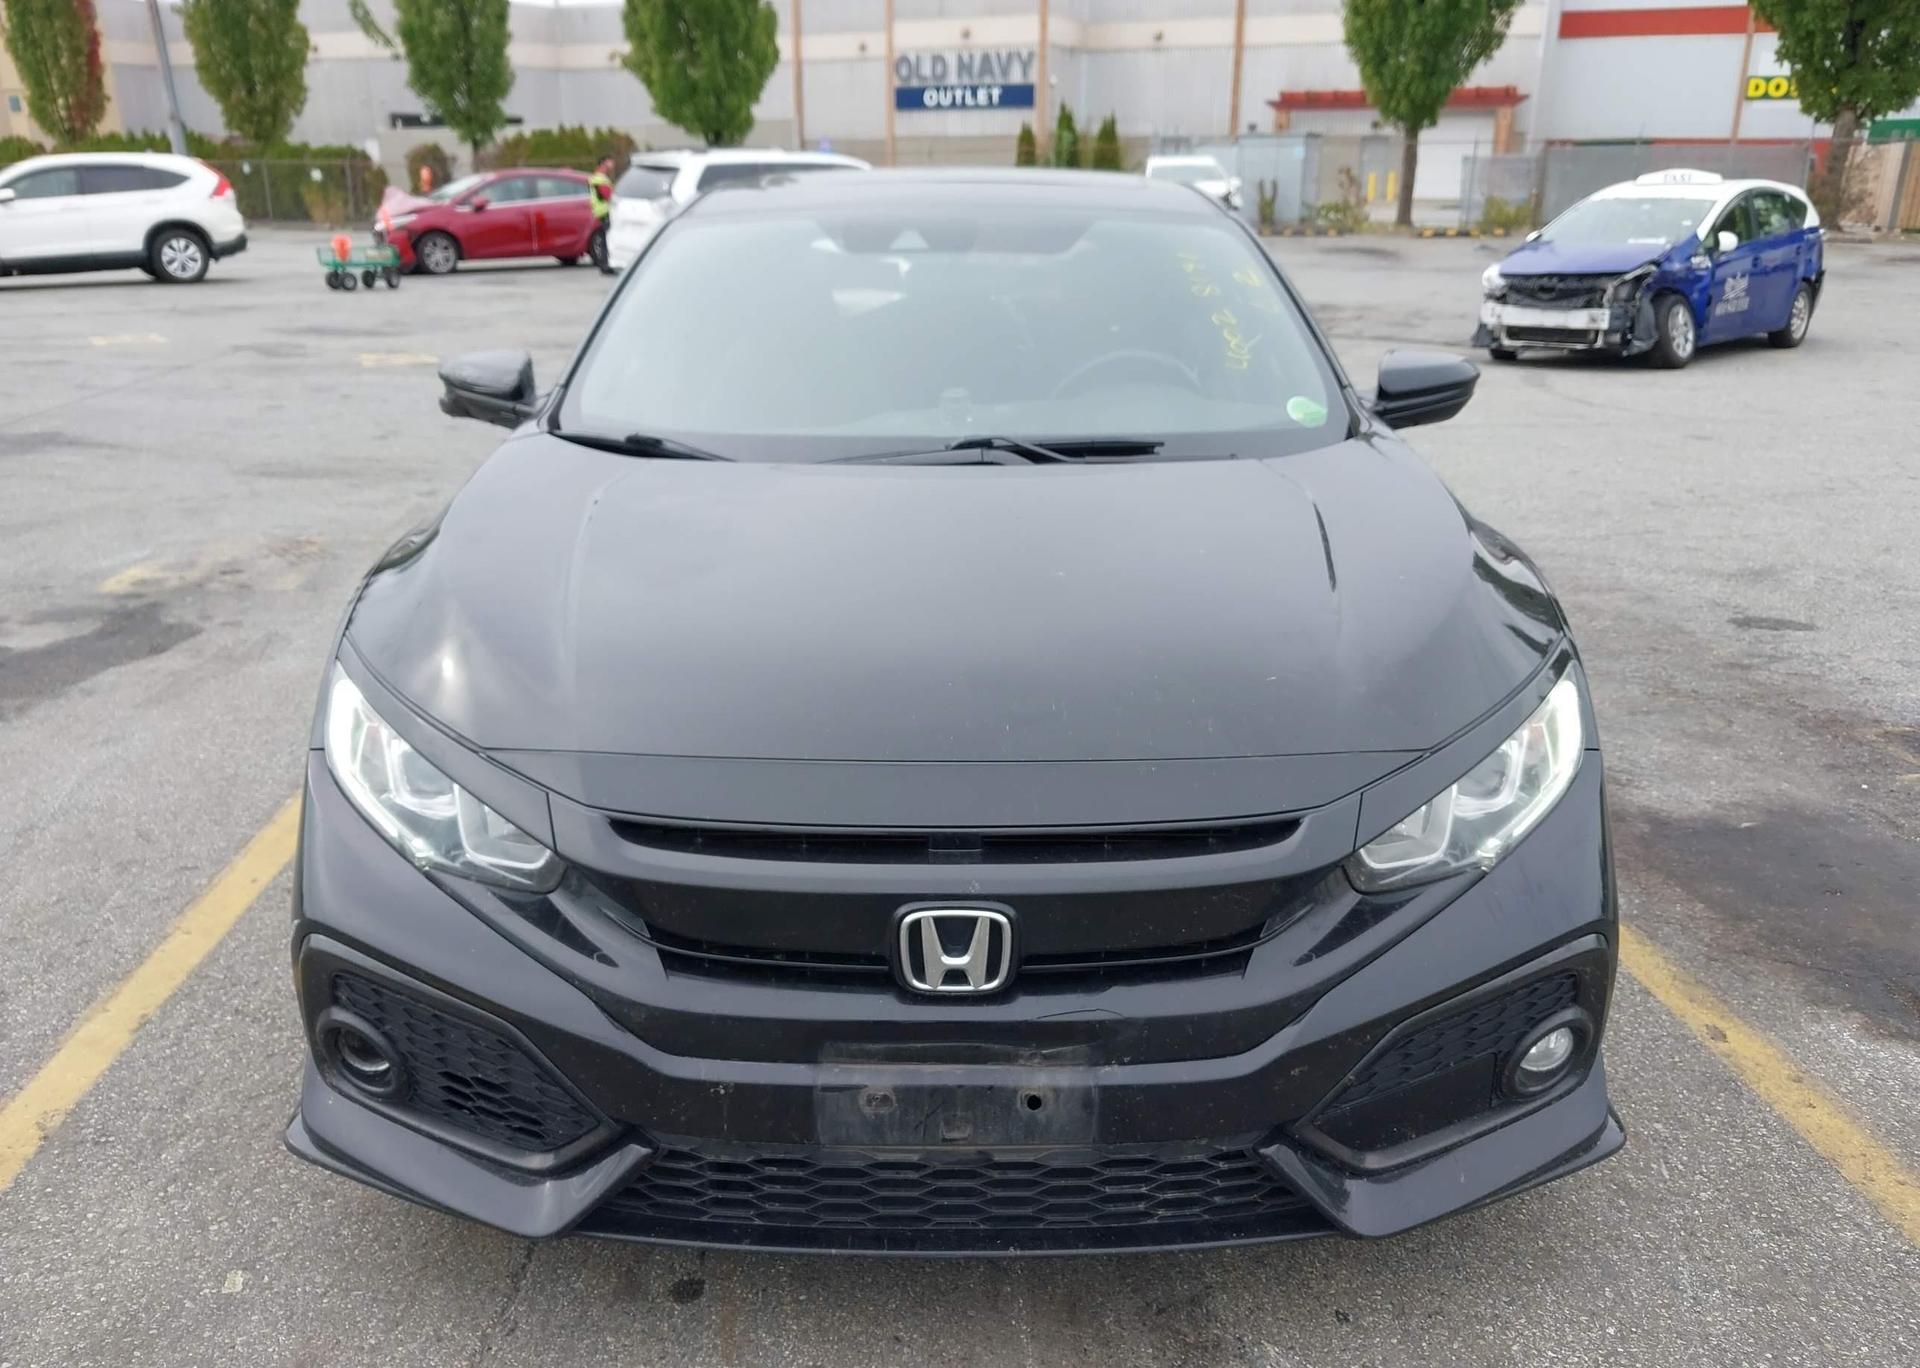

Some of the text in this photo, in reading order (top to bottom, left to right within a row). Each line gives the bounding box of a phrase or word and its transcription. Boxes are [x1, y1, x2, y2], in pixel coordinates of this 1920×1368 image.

[896, 51, 1034, 81] OLD NAVY
[923, 87, 1001, 107] OUTLET
